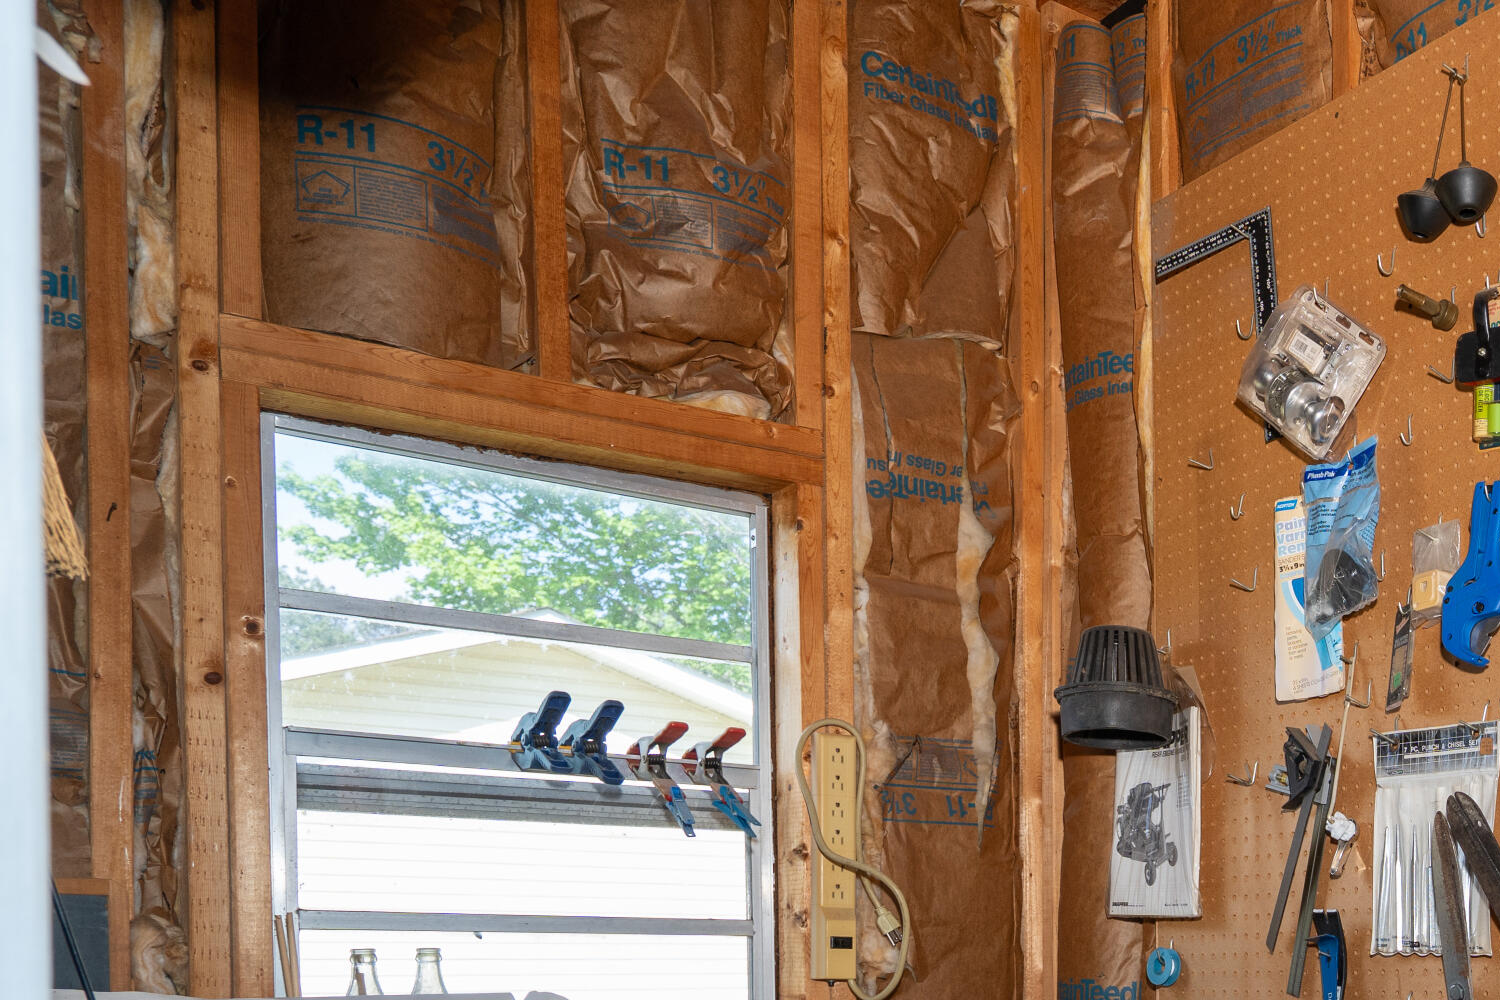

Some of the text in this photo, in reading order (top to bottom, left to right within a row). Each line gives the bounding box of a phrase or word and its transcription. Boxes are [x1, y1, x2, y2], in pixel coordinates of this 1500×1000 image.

[863, 82, 951, 121] Fiber Glass
[298, 114, 375, 152] R-11
[604, 148, 669, 181] R-11
[906, 454, 947, 477] Glass
[1447, 740, 1467, 748] CHISEL
[1468, 739, 1479, 747] SET
